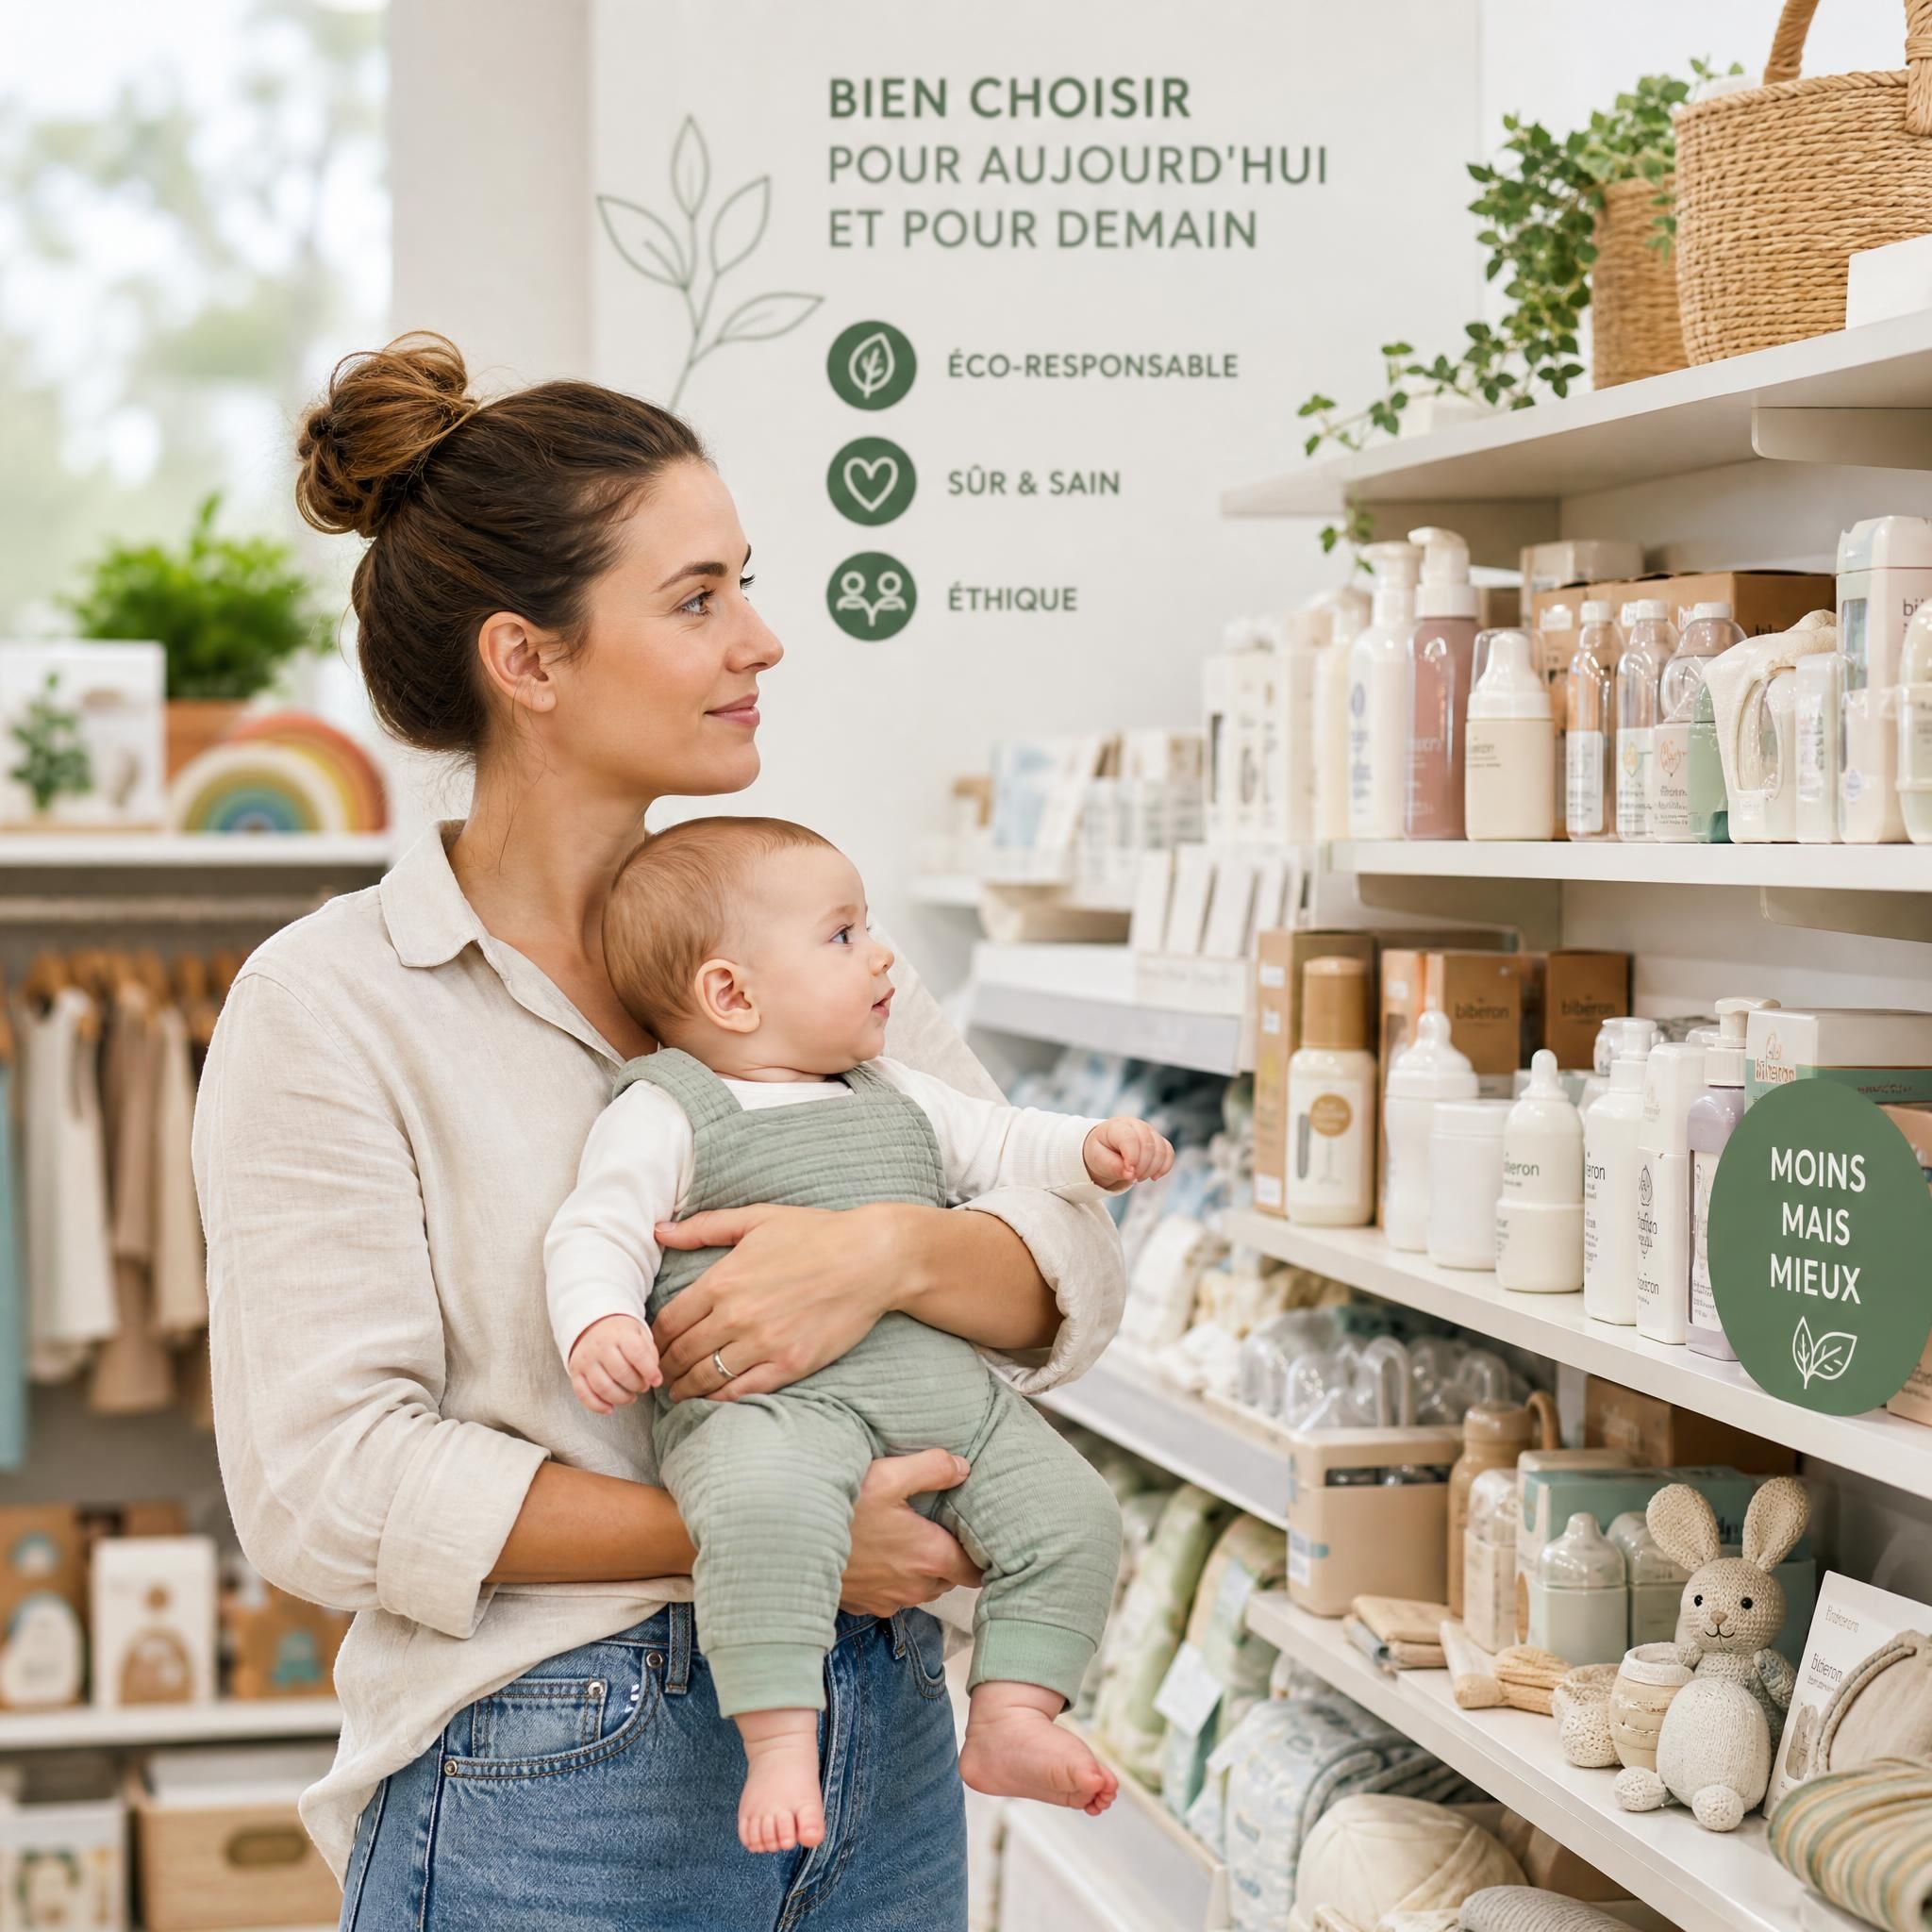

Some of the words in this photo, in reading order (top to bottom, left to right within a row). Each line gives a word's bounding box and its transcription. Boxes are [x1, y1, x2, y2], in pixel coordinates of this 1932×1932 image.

[830, 77, 947, 119] BIEN
[970, 76, 1191, 119] CHOISIR
[830, 145, 960, 185] POUR
[979, 144, 1326, 186] AUJOURD'HUI
[830, 209, 884, 248] ET
[904, 208, 1037, 248] POUR
[1058, 209, 1257, 248] DEMAIN
[948, 349, 1239, 378] ÉCO-RESPONSABLE
[949, 464, 1007, 496] SÛR
[1018, 470, 1039, 496] &
[1049, 470, 1121, 496] SAIN
[948, 581, 1077, 613] ÉTHIQUE
[1771, 1146, 1866, 1192] MOINS
[1782, 1202, 1851, 1246] MAIS
[1770, 1253, 1861, 1305] MIEUX
